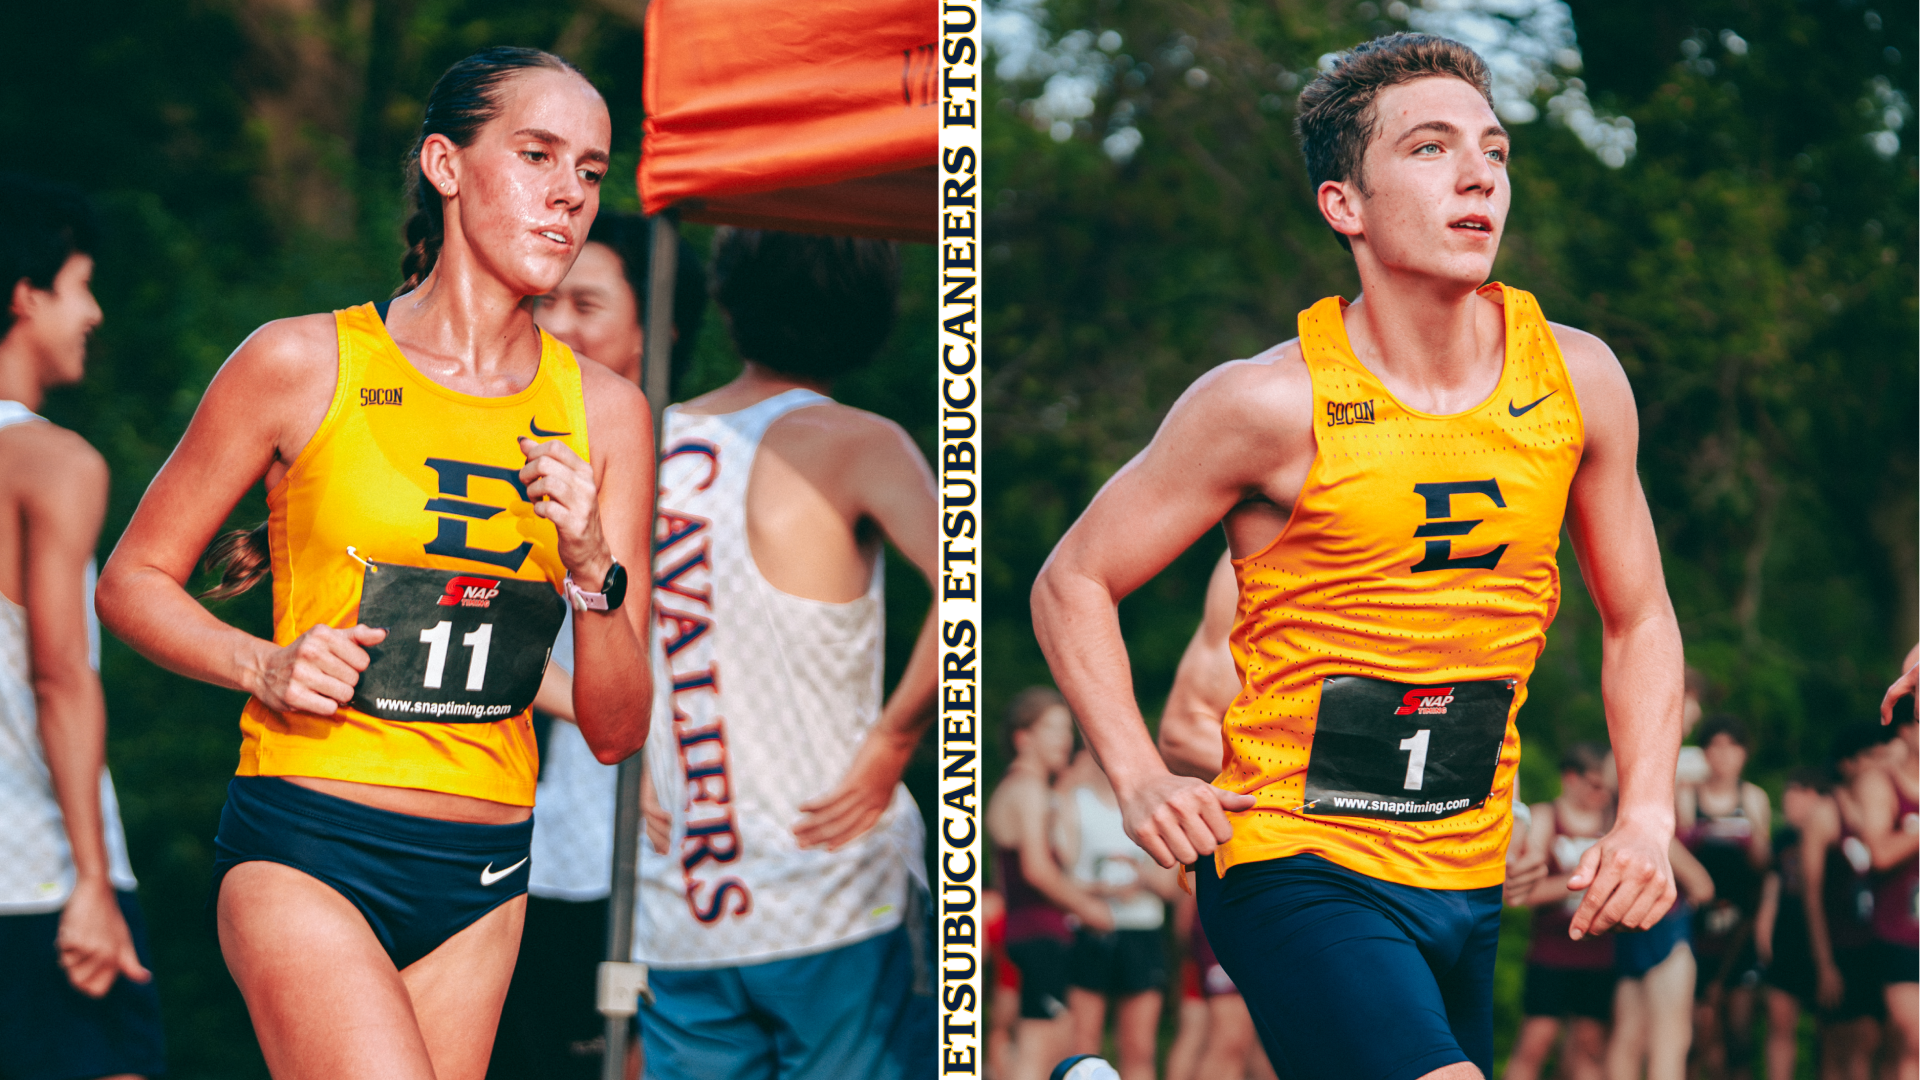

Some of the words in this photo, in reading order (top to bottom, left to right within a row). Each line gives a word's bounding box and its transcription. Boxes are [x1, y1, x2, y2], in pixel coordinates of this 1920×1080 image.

[423, 457, 534, 574] E
[1410, 477, 1508, 573] E
[436, 575, 501, 606] SNAP
[461, 598, 490, 608] TIMING
[419, 620, 494, 692] 11
[655, 437, 752, 924] CAVALIERS
[376, 697, 512, 719] www.snaptiming.com
[1393, 686, 1455, 715] SNAP
[1417, 706, 1447, 715] TIMING
[1399, 729, 1431, 791] 1
[1333, 797, 1470, 815] www.snaptiming.com
